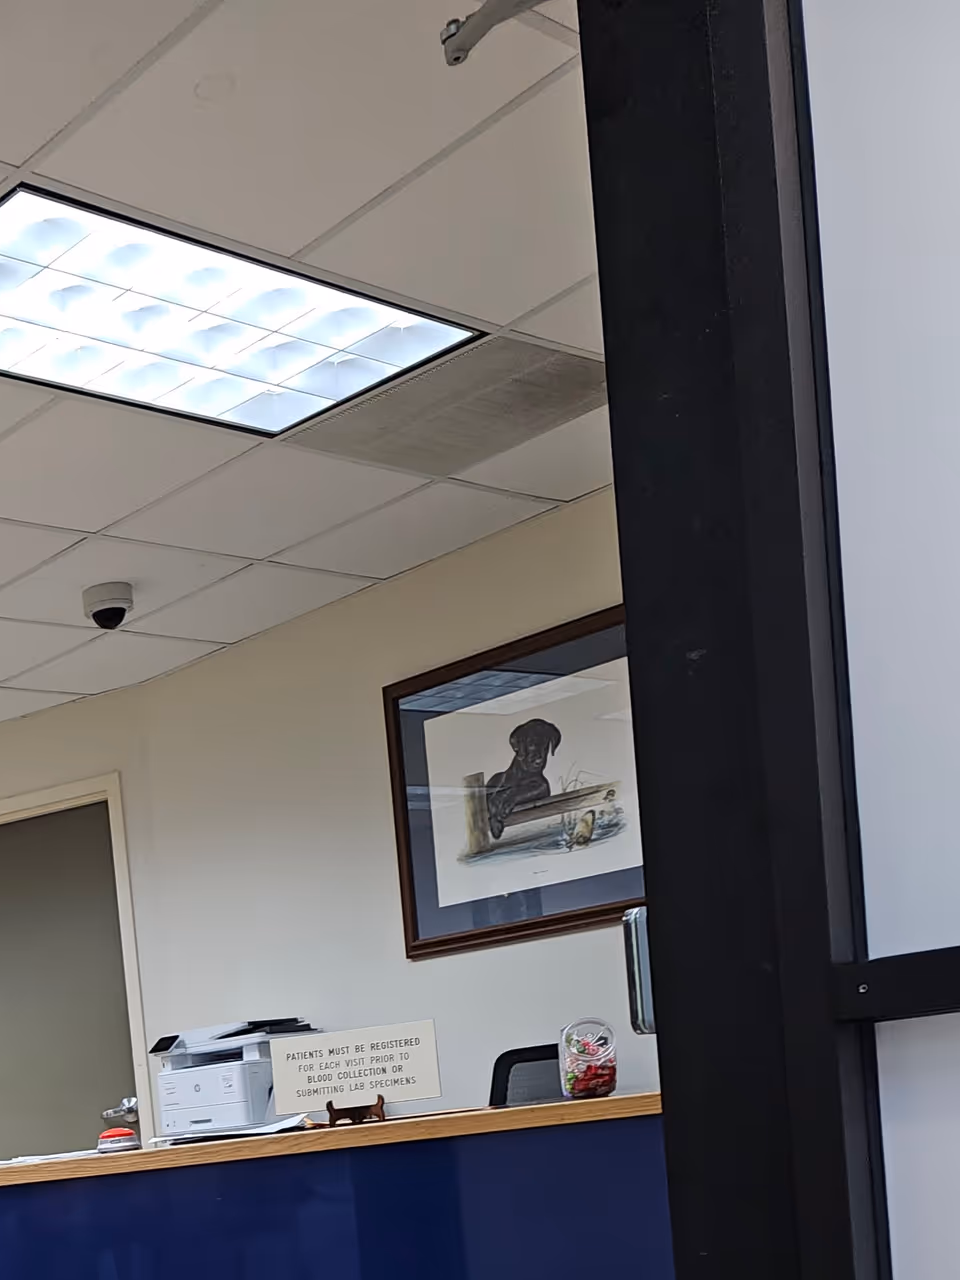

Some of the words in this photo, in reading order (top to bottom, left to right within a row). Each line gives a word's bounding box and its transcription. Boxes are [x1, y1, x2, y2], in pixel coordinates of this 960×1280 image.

[286, 1050, 324, 1061] PATIENTS
[328, 1046, 350, 1057] MUST
[354, 1044, 366, 1053] BE
[370, 1037, 421, 1051] REGISTERED
[298, 1063, 315, 1073] FOR
[319, 1061, 341, 1071] EACH
[346, 1057, 365, 1068] VISIT
[370, 1054, 395, 1065] PRIOR
[399, 1052, 410, 1061] TO
[307, 1073, 333, 1084] BLOOD
[337, 1066, 387, 1080] COLLECTION
[391, 1064, 404, 1074] OR
[296, 1085, 345, 1098] SUBMITTING
[349, 1082, 365, 1092] LAB
[369, 1076, 417, 1089] SPECIMENS
